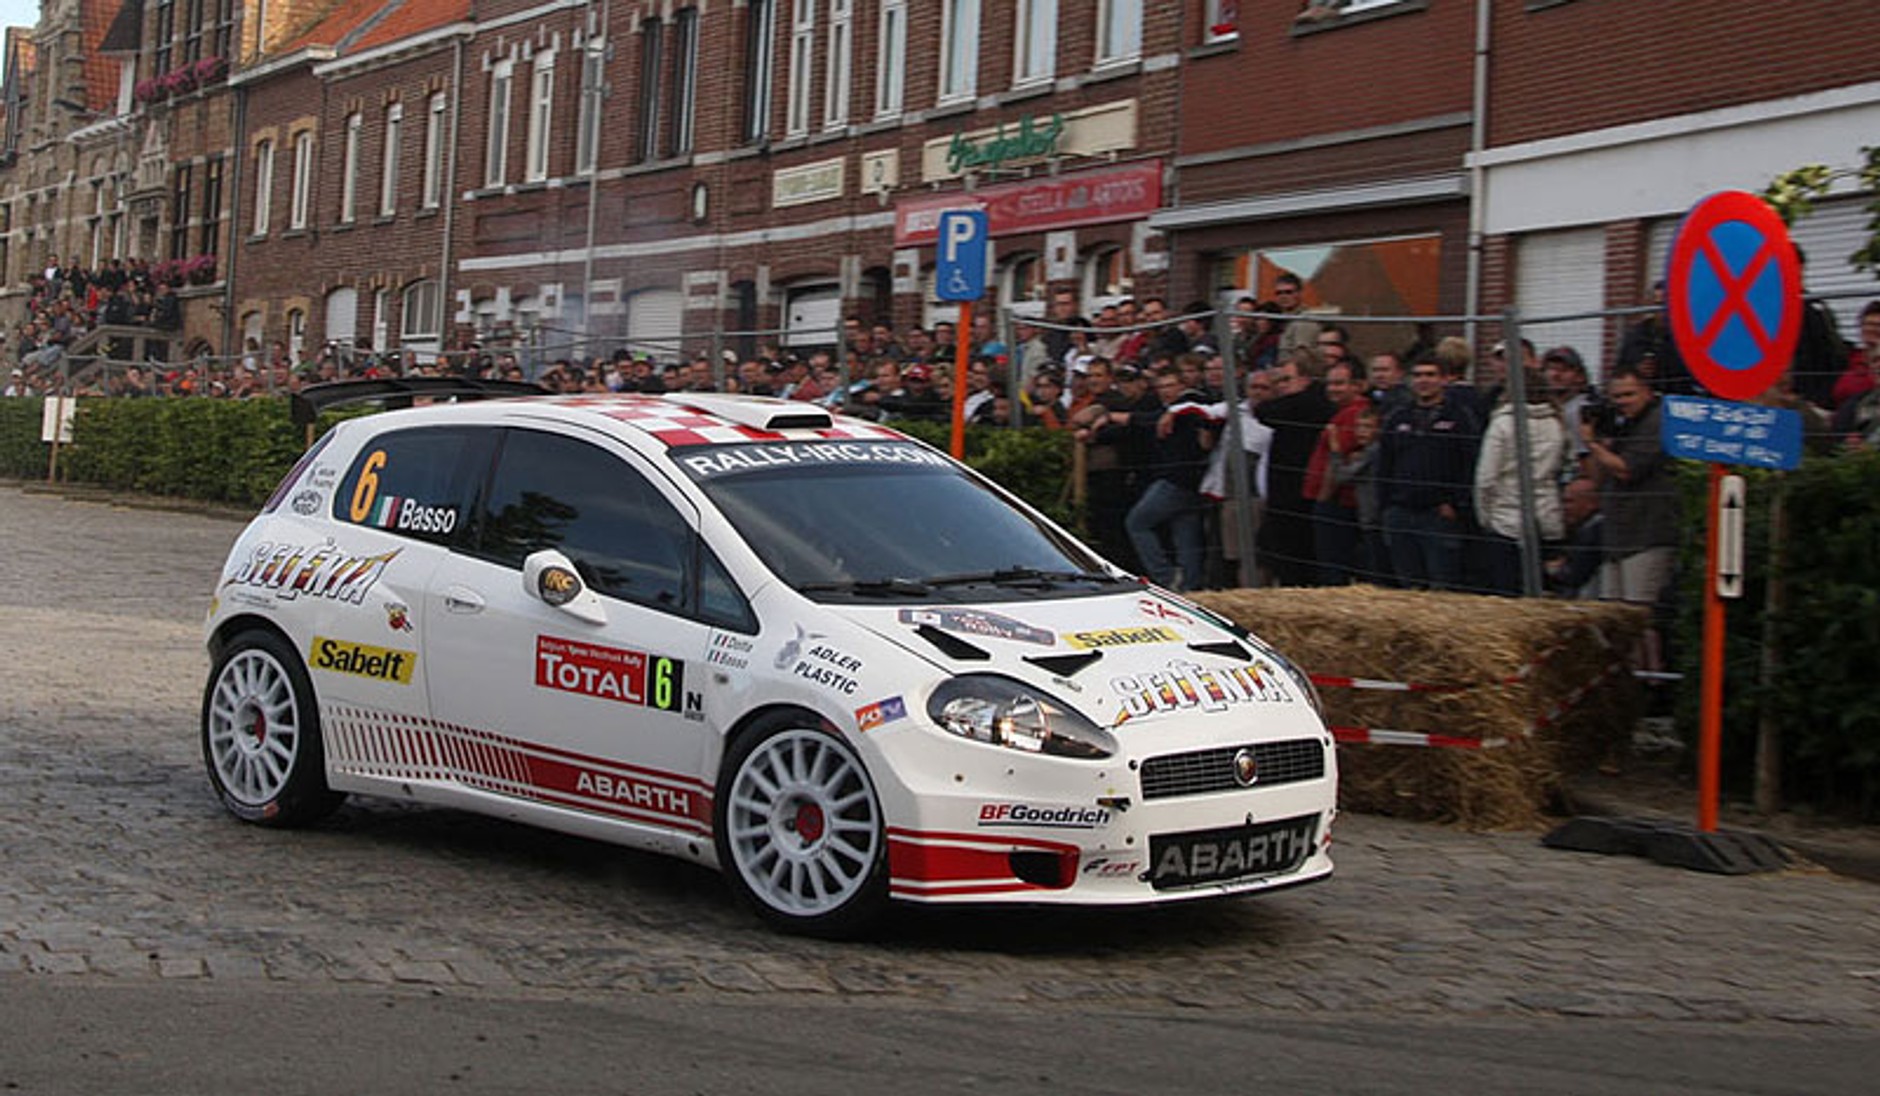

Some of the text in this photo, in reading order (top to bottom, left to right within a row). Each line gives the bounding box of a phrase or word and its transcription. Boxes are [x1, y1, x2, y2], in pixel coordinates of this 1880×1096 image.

[946, 215, 976, 262] P
[350, 450, 387, 522] 6
[398, 498, 456, 533] Basso
[318, 639, 405, 681] Sabelt
[540, 652, 642, 702] TOTAL
[794, 661, 859, 695] PLASTIC
[809, 645, 863, 672] ADLER
[656, 657, 674, 710] 6
[686, 691, 703, 711] N
[576, 770, 692, 815] ABARTH
[979, 804, 1110, 824] BFGoodrich
[1157, 828, 1310, 879] ABARTH
